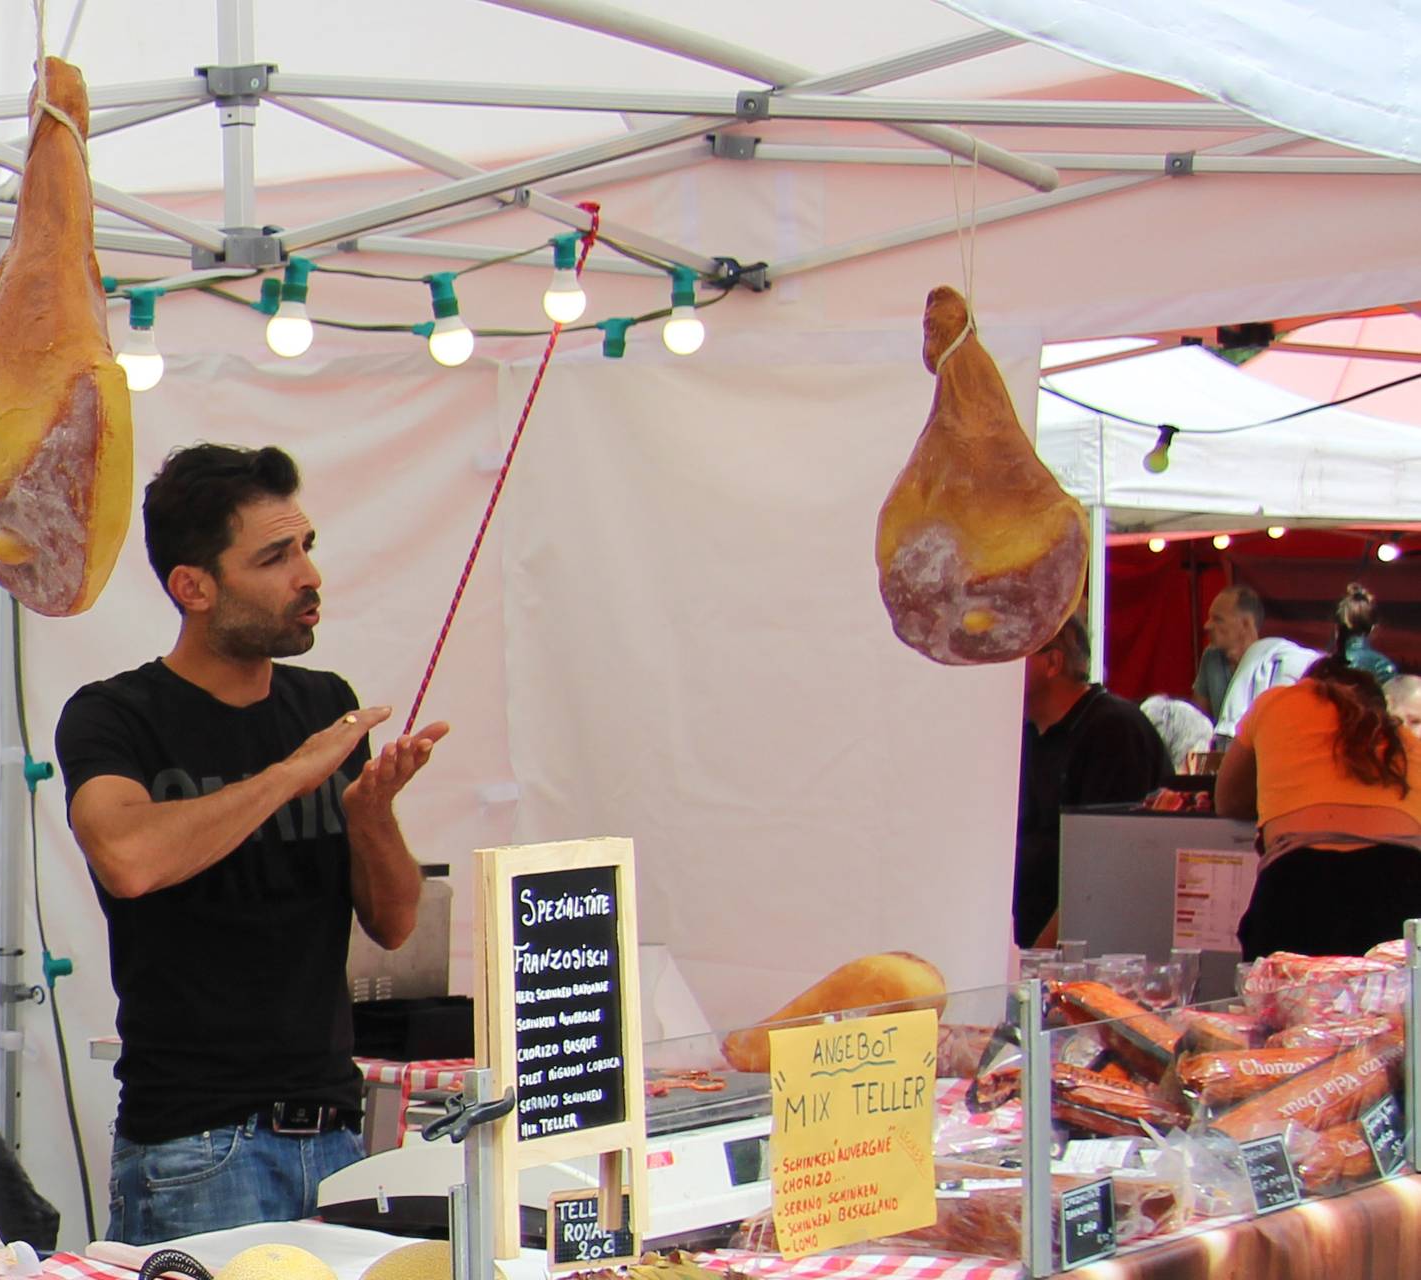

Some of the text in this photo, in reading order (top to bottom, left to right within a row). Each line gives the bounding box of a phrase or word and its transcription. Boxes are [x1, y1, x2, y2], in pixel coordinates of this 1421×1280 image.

[517, 1035, 598, 1062] CHORIZO BASQUE
[519, 1070, 544, 1087] FILET
[852, 1076, 926, 1116] TELLER
[539, 1113, 577, 1134] TELLER
[782, 1152, 835, 1174] SCHINKEN
[828, 1184, 879, 1204] SCHINKEN
